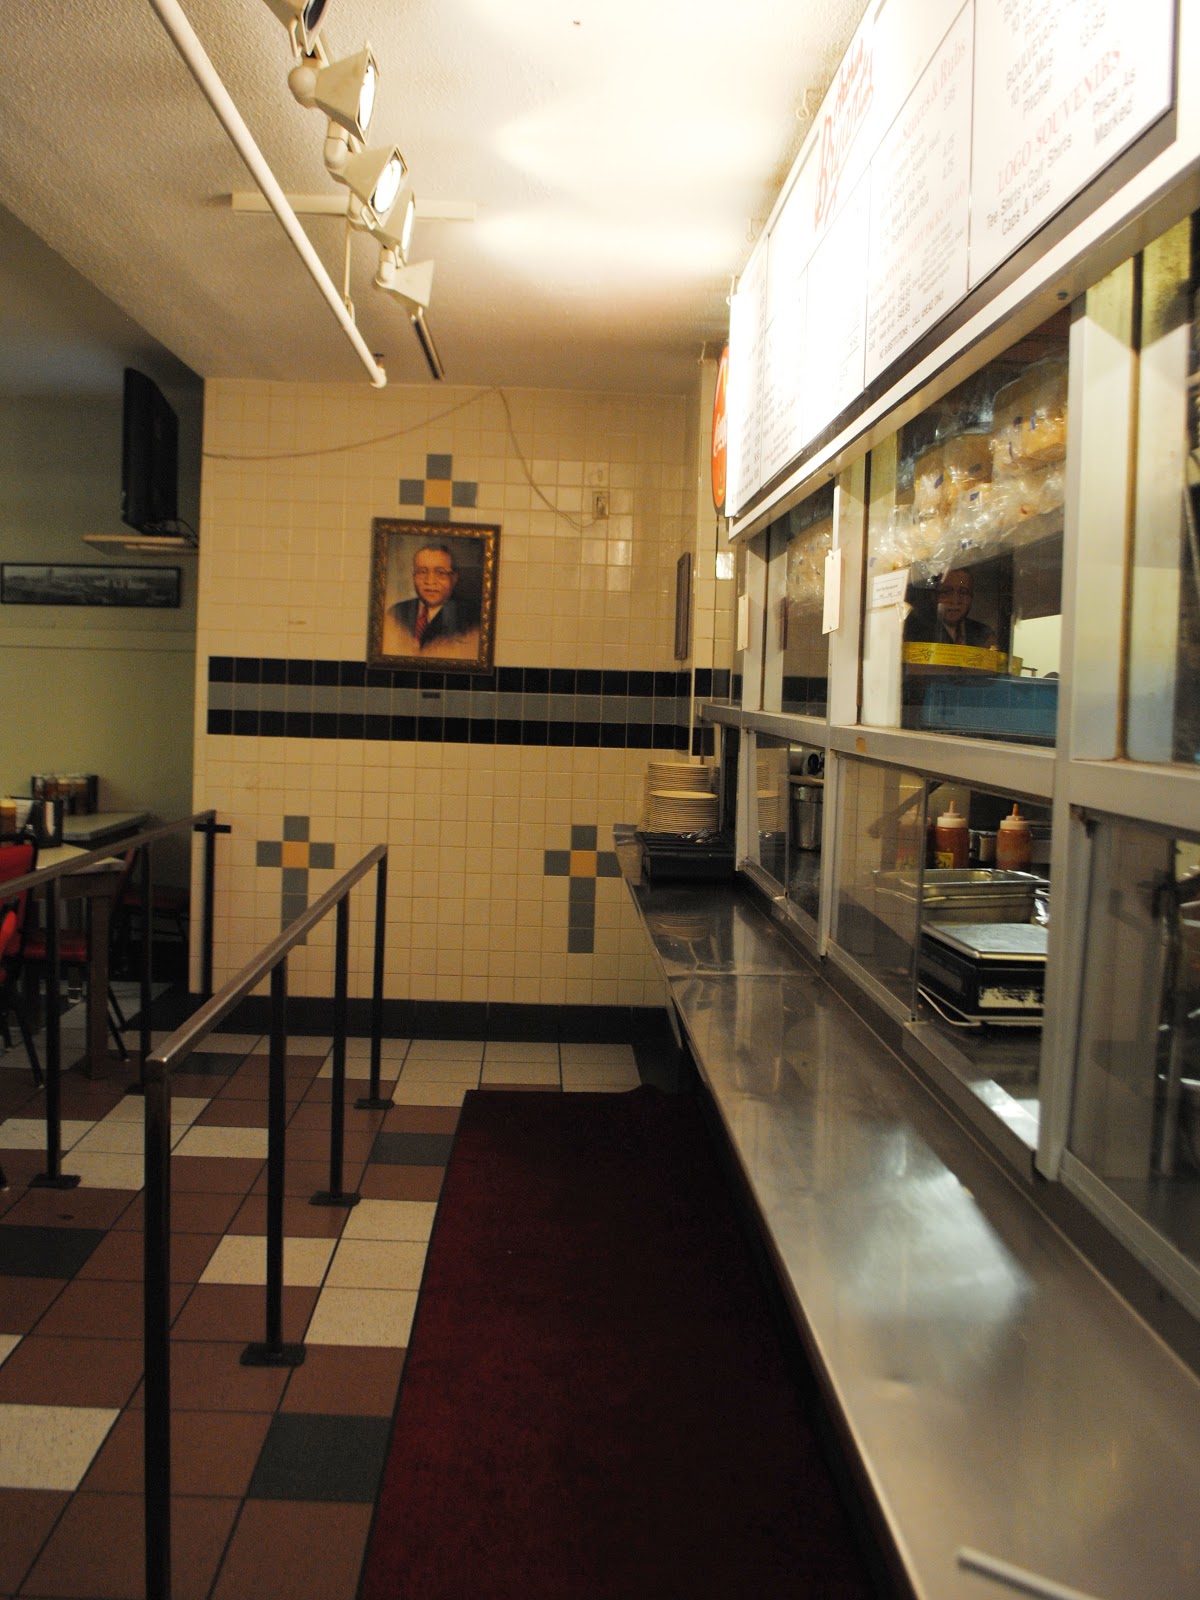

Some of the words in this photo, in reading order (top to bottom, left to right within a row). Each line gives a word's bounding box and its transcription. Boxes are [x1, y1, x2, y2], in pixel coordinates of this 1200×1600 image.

[997, 140, 1032, 194] LOGO
[1035, 48, 1120, 154] SOUVENIRS
[1047, 133, 1072, 168] Shirts
